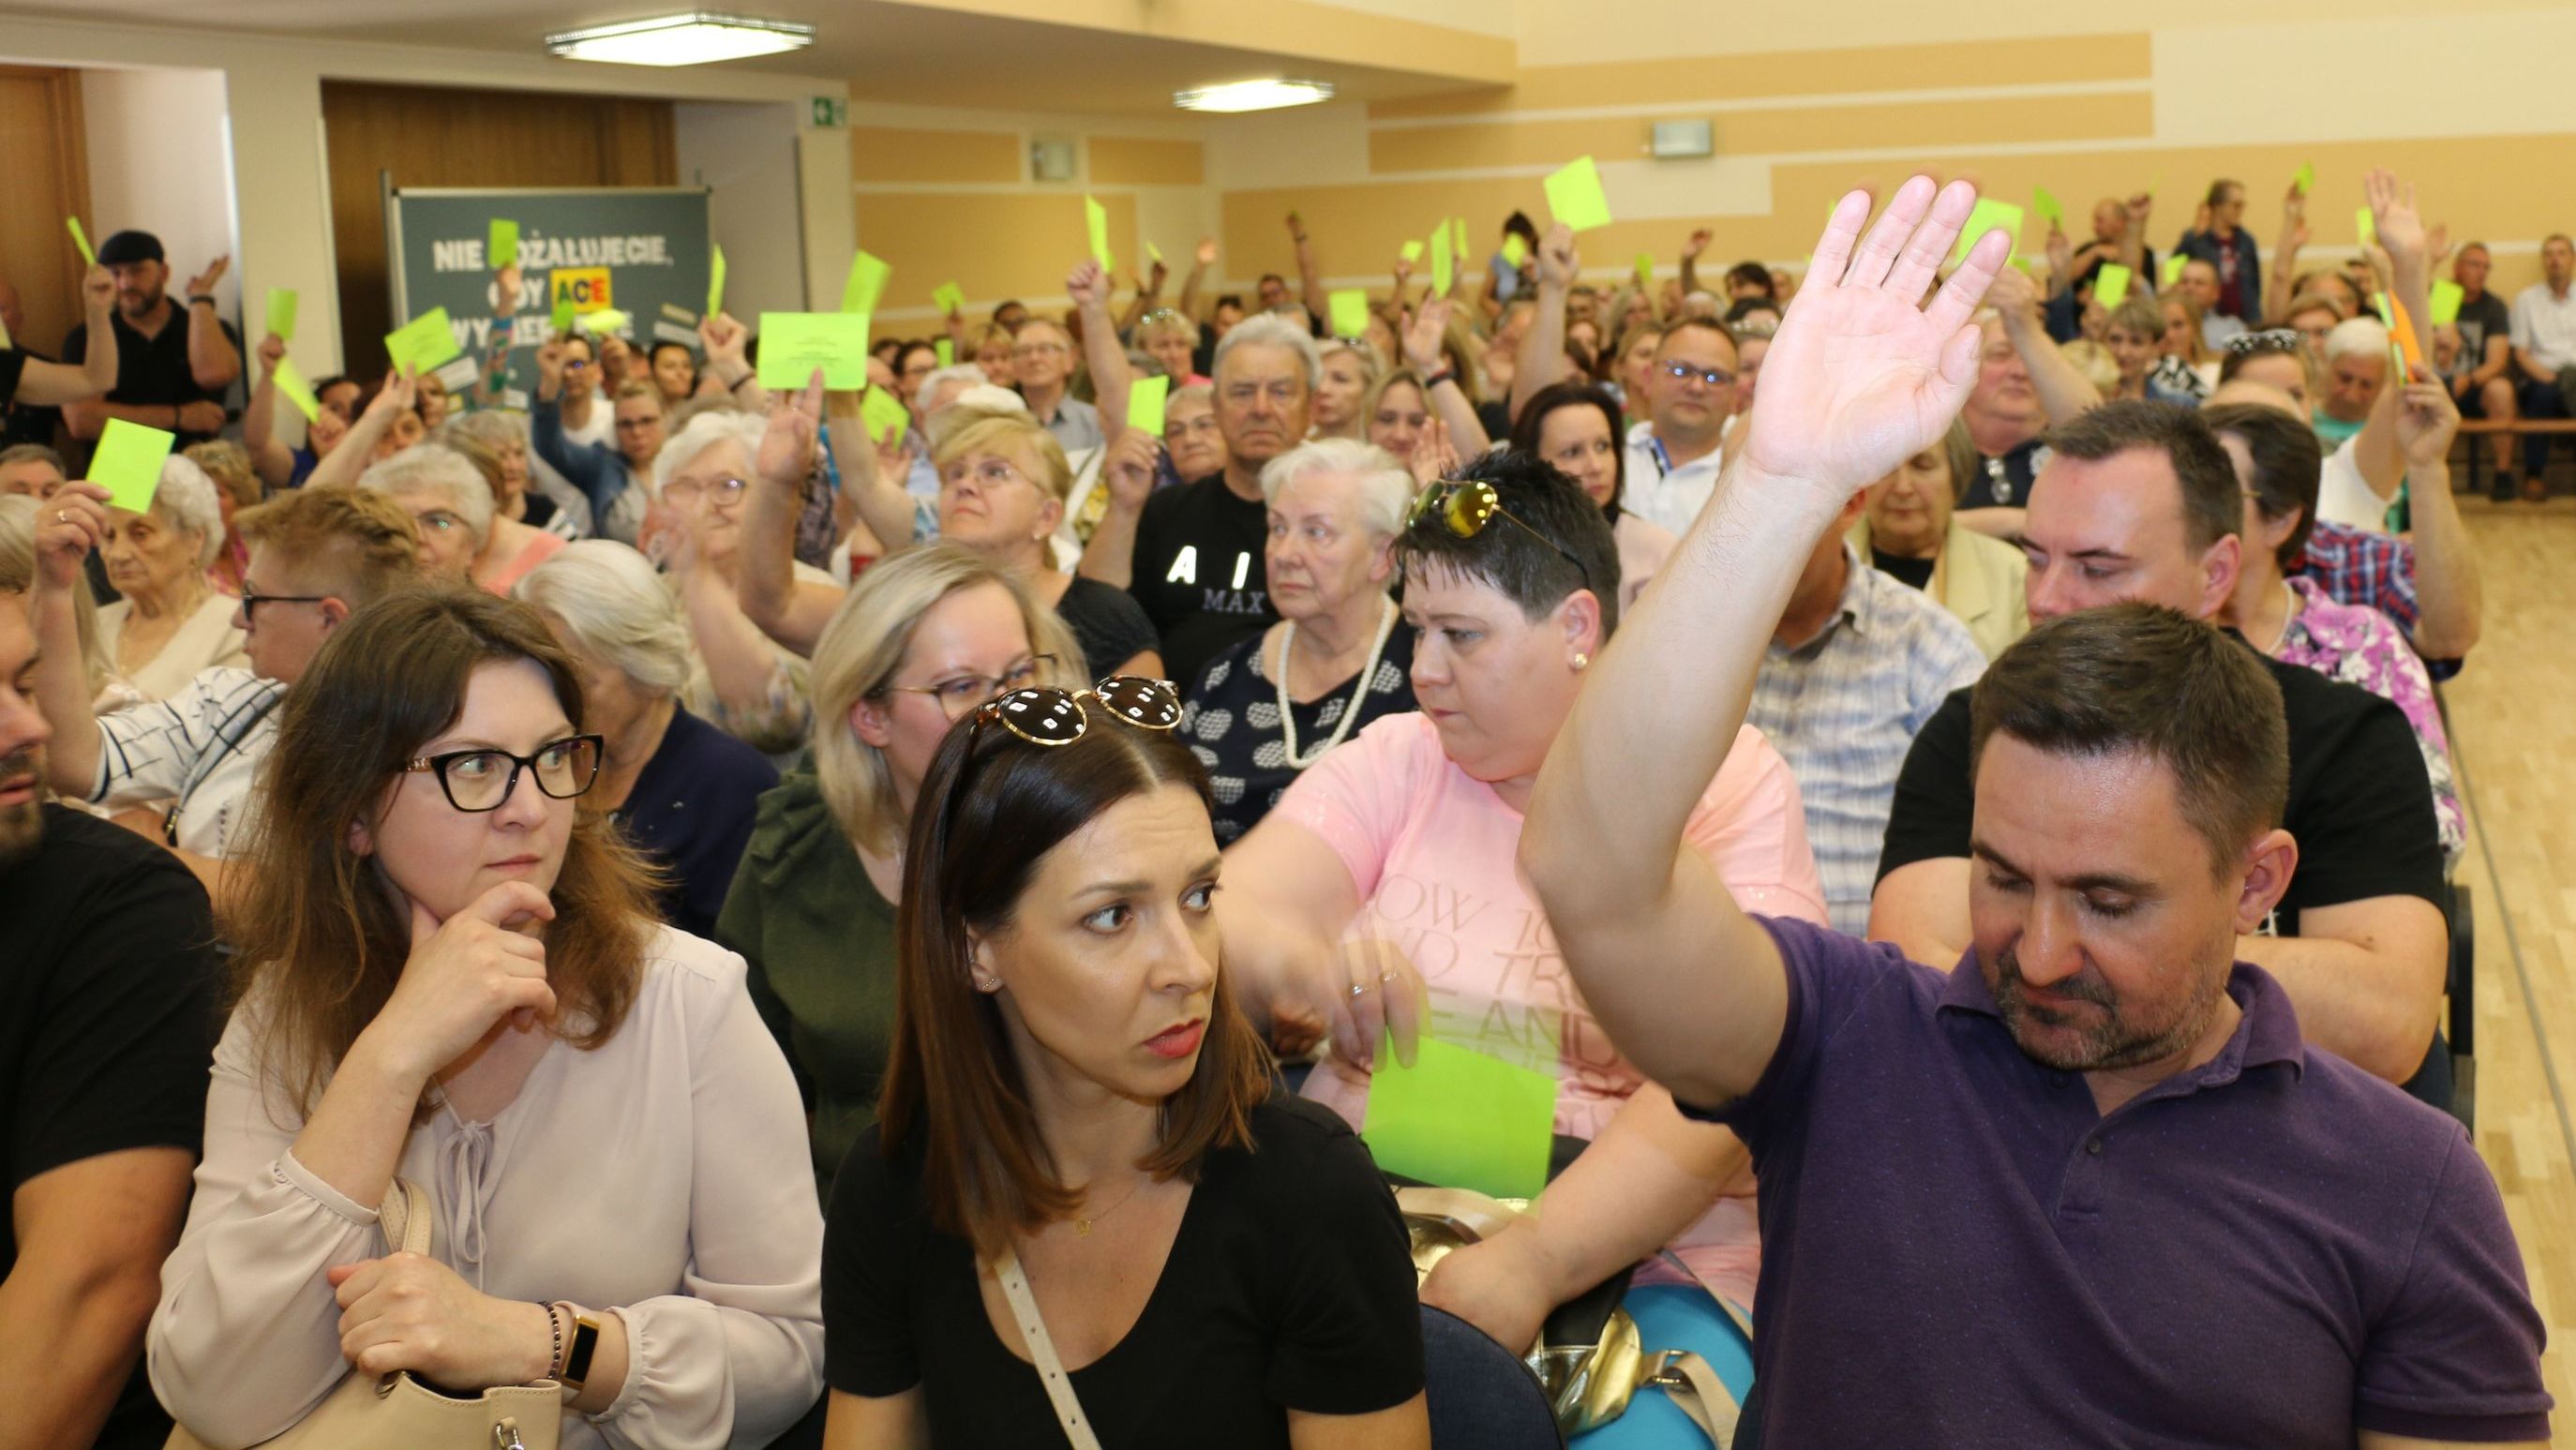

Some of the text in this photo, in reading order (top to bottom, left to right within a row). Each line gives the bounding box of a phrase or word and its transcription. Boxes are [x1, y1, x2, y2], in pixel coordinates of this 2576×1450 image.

[432, 239, 485, 272] NIE
[556, 277, 607, 307] ACE
[1202, 587, 1266, 615] MAX
[1374, 874, 1493, 934] OW
[1475, 997, 1621, 1069] AND
